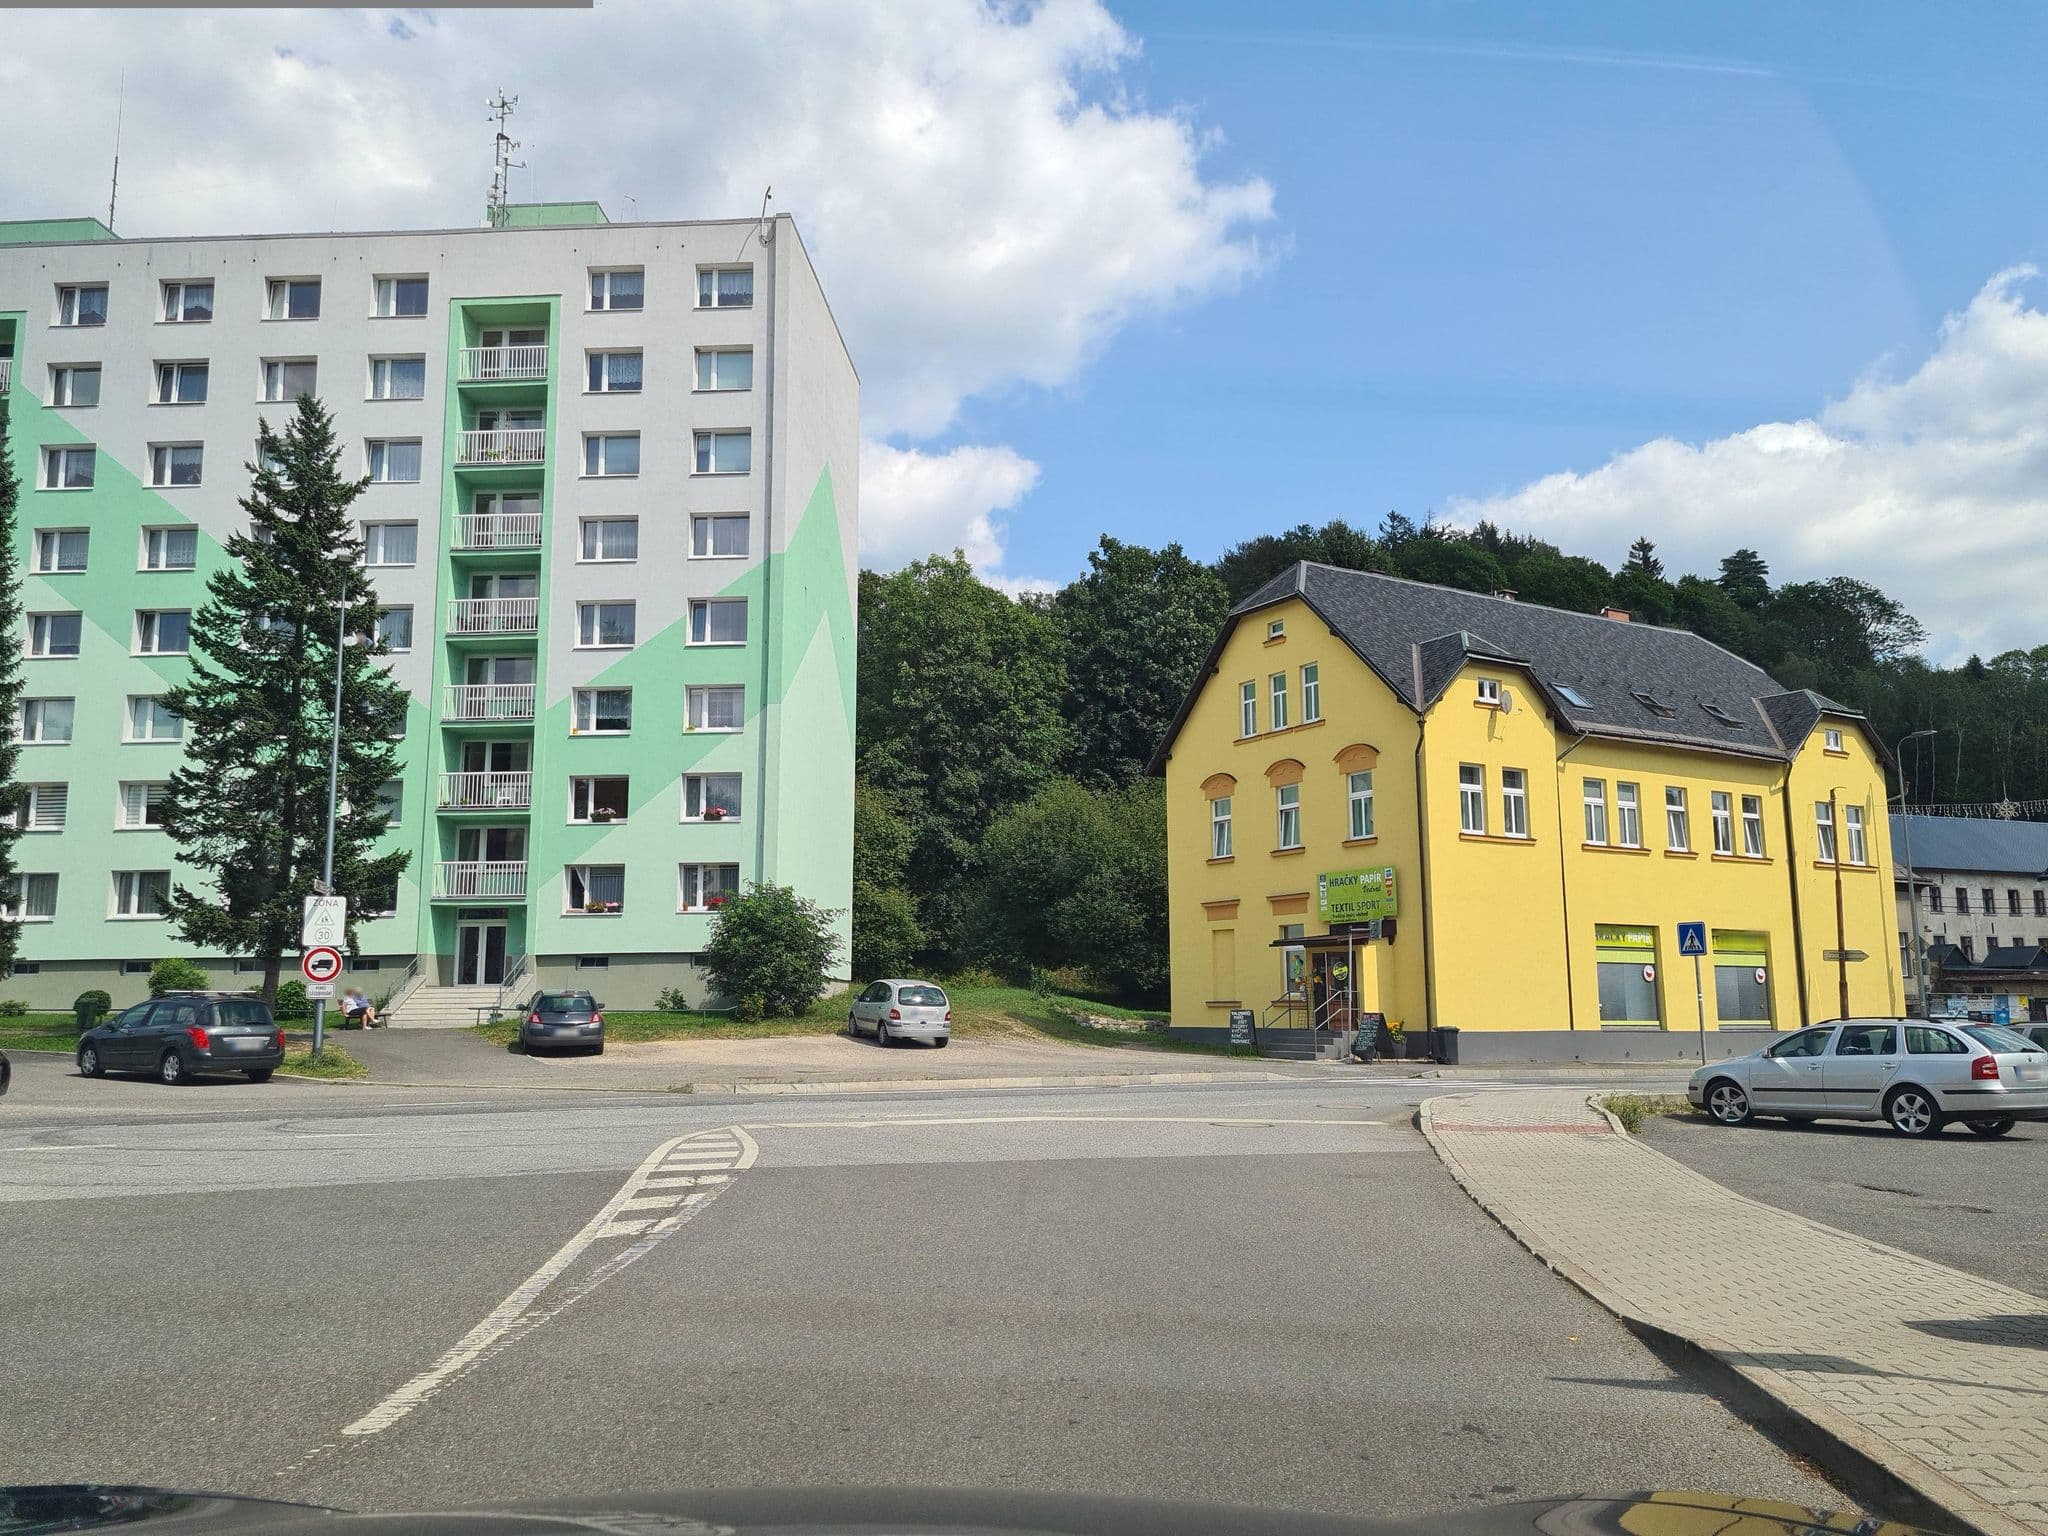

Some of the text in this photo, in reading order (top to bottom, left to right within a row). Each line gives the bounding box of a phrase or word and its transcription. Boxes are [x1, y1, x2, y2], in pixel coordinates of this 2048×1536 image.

[1329, 871, 1381, 887] HRAČKY PAPÍR
[1331, 900, 1380, 913] TEXTIL SPORT
[317, 931, 330, 940] 30
